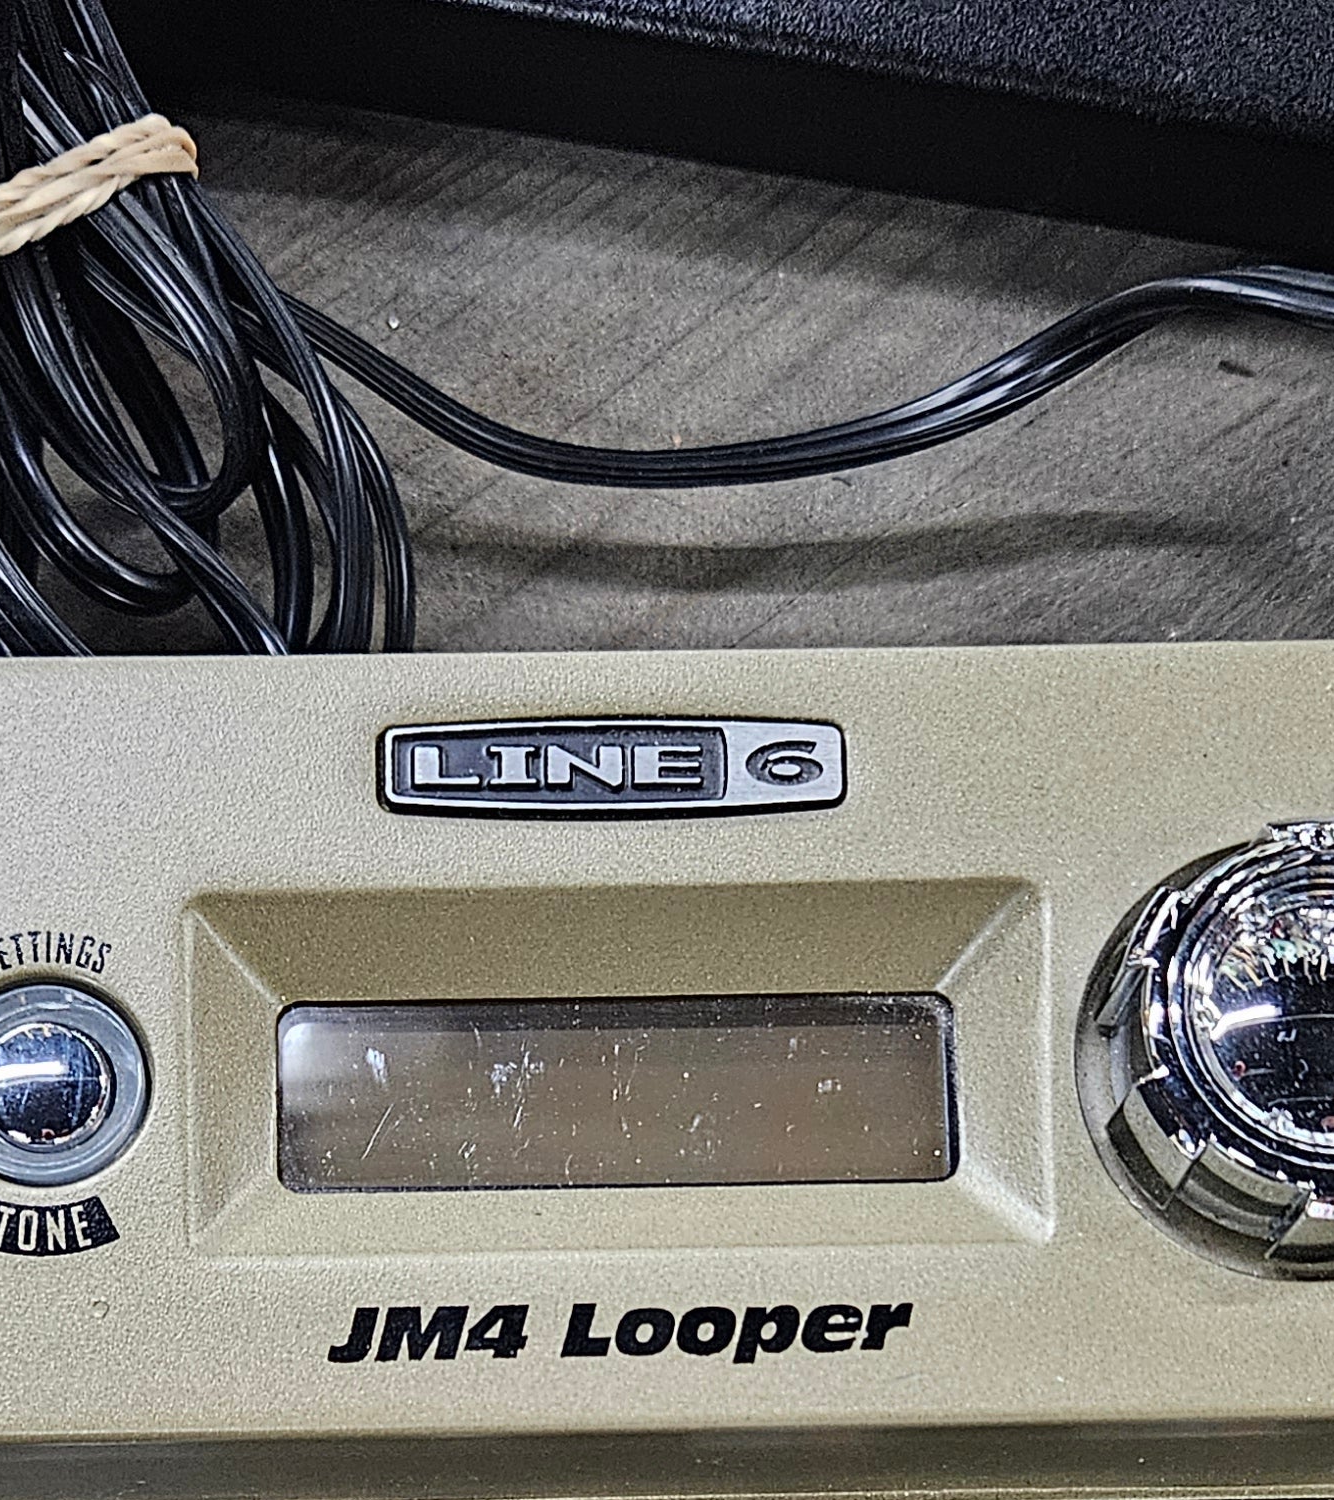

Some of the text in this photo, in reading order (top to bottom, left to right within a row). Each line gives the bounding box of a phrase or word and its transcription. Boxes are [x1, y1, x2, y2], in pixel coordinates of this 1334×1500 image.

[411, 740, 824, 791] LINE 6
[327, 1301, 913, 1364] JM4 Looper
